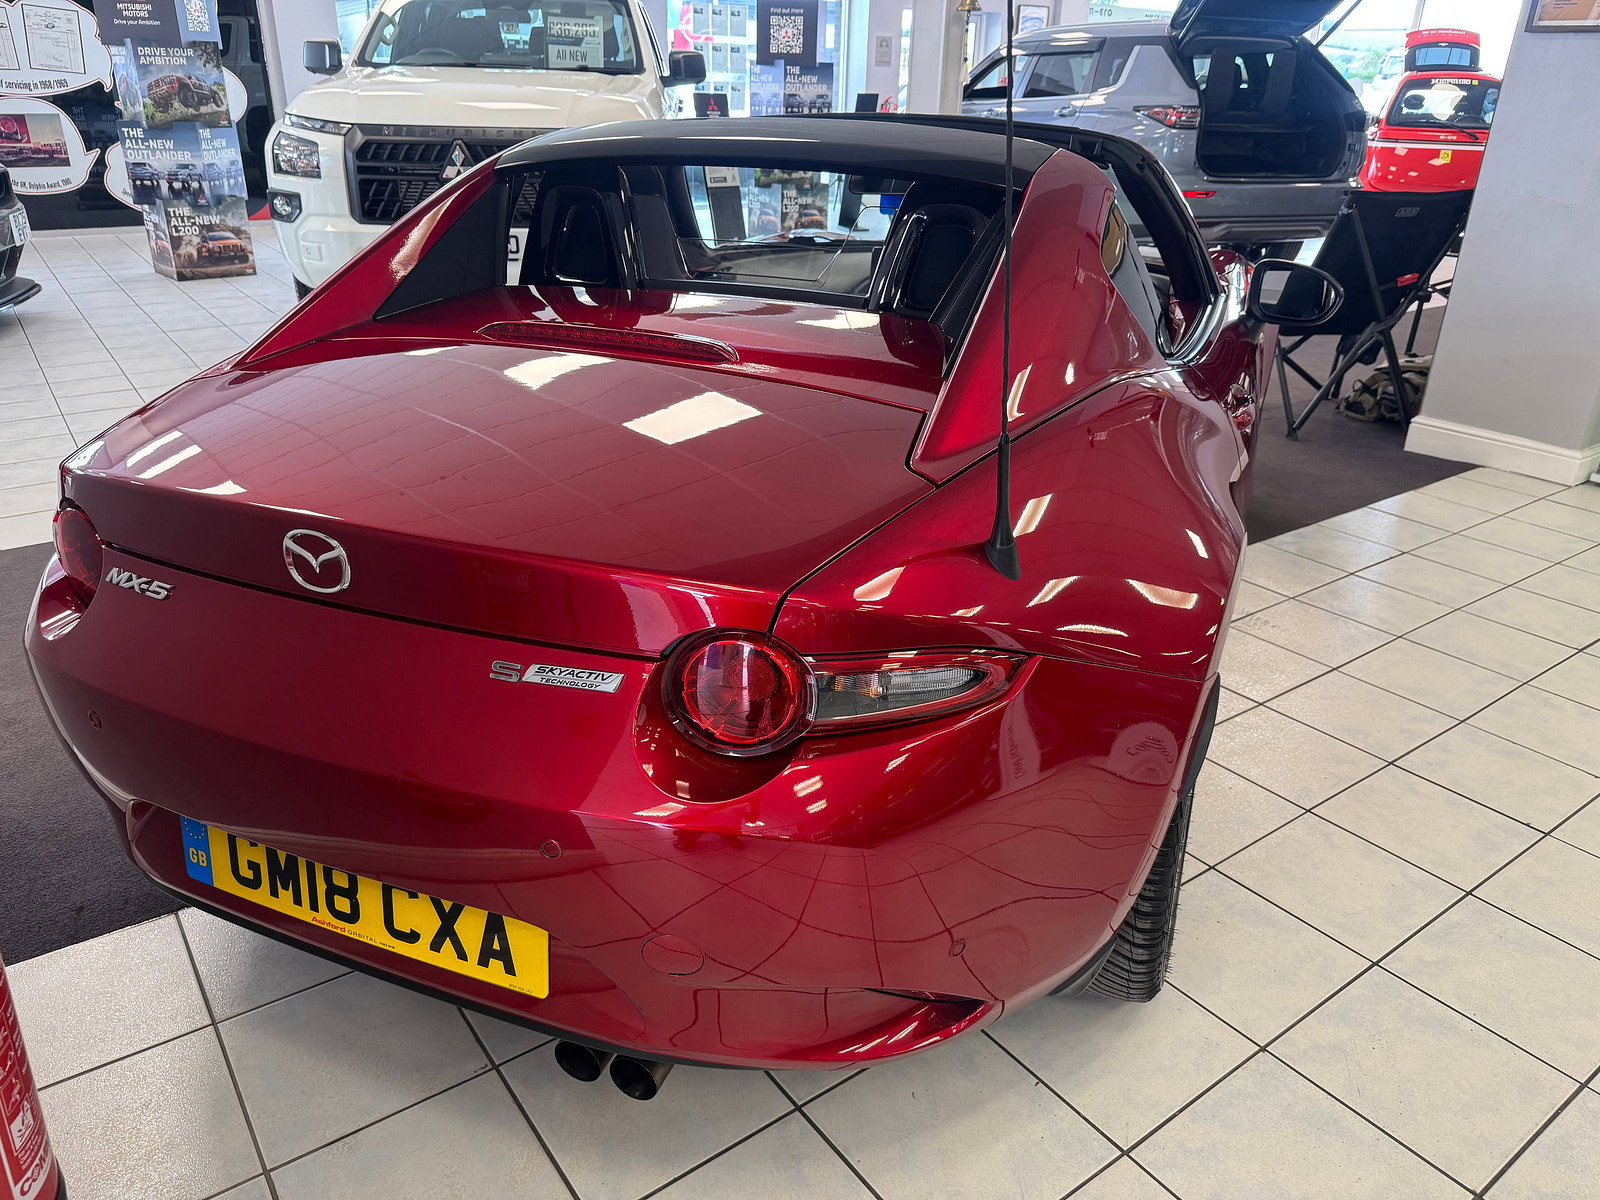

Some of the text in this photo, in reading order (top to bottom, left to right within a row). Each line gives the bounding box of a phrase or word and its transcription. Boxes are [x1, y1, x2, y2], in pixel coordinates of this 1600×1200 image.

[116, 2, 152, 11] MITSUBISHI
[122, 10, 149, 18] MOTORS
[137, 46, 167, 56] DRIVE
[168, 47, 195, 57] YOUR
[556, 49, 588, 62] All NEW
[139, 55, 187, 66] AMBITION
[785, 65, 801, 74] THE
[785, 75, 818, 84] ALL-NEW
[5, 80, 32, 92] servicing
[32, 80, 39, 90] in
[785, 83, 828, 92] OUTLANDER
[121, 127, 145, 138] THE
[199, 129, 212, 139] THE
[125, 139, 174, 150] ALL-NEW
[201, 138, 227, 150] ALL-NEW
[127, 150, 192, 161] OUTLANDER
[203, 148, 236, 160] OUTLANDER
[783, 190, 798, 198] THE
[167, 207, 191, 217] THE
[170, 215, 220, 227] ALL-NEW
[172, 226, 200, 237] L200
[105, 566, 175, 600] MX-5
[534, 665, 614, 682] SKYACTIV
[539, 677, 601, 689] TECHNOLOGY
[189, 847, 208, 867] GB
[227, 833, 517, 977] GM18 CXA
[311, 916, 378, 944] Ashford ORBITAL
